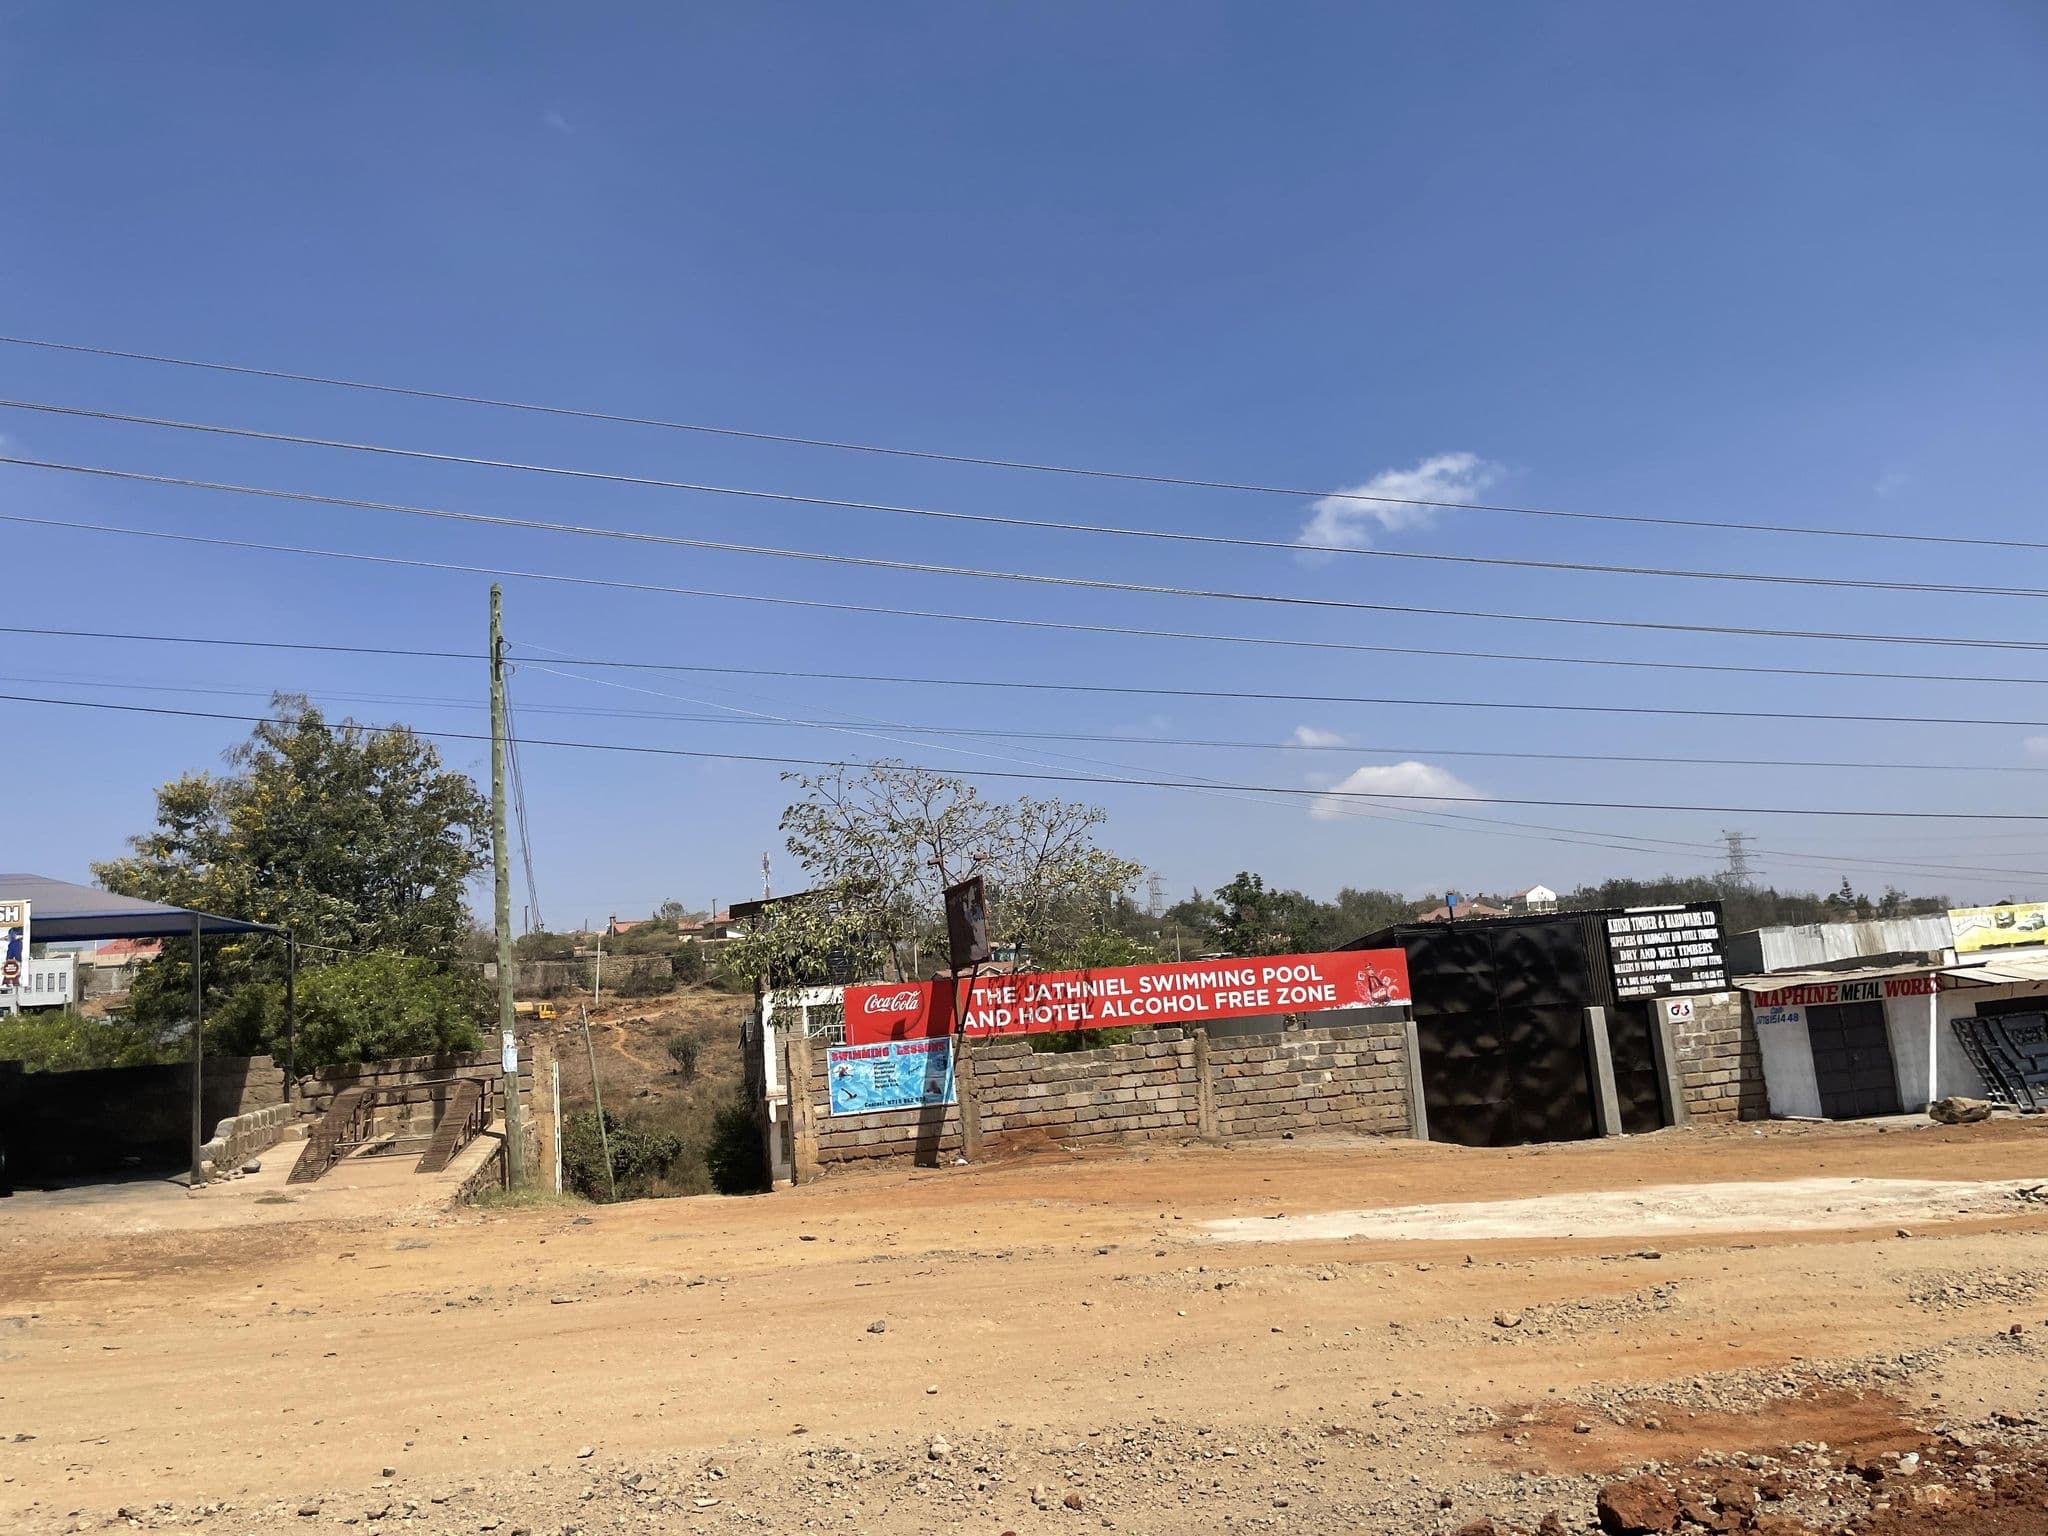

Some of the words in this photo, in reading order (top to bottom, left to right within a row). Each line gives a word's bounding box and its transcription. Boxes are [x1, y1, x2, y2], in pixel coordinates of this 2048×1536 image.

[1630, 916, 1658, 931] TIMBER
[1658, 915, 1664, 929] &
[1664, 912, 1703, 928] HARDWARE
[1702, 911, 1715, 925] LTD
[1610, 935, 1637, 947] SUPPLIERS
[1619, 949, 1638, 961] DRY
[1640, 947, 1656, 960] AND
[1657, 946, 1676, 958] WET
[1677, 942, 1714, 956] TIMBERS
[972, 987, 1016, 1007] THE
[1023, 975, 1133, 1002] JATHNIEL
[1138, 968, 1256, 993] SWIMMING
[1263, 964, 1323, 984] POOL
[1754, 984, 1839, 1008] MAPHINE
[1840, 982, 1883, 1001] METAL
[1884, 976, 1944, 998] WORKS
[963, 1009, 1011, 1029] AND
[1019, 1004, 1094, 1025] HOTEL
[1100, 994, 1209, 1018] ALCOHOL
[1215, 989, 1270, 1011] FREE
[1277, 984, 1337, 1005] ZONE
[831, 1046, 890, 1062] SWIMMING
[896, 1041, 945, 1056] LESSONS
